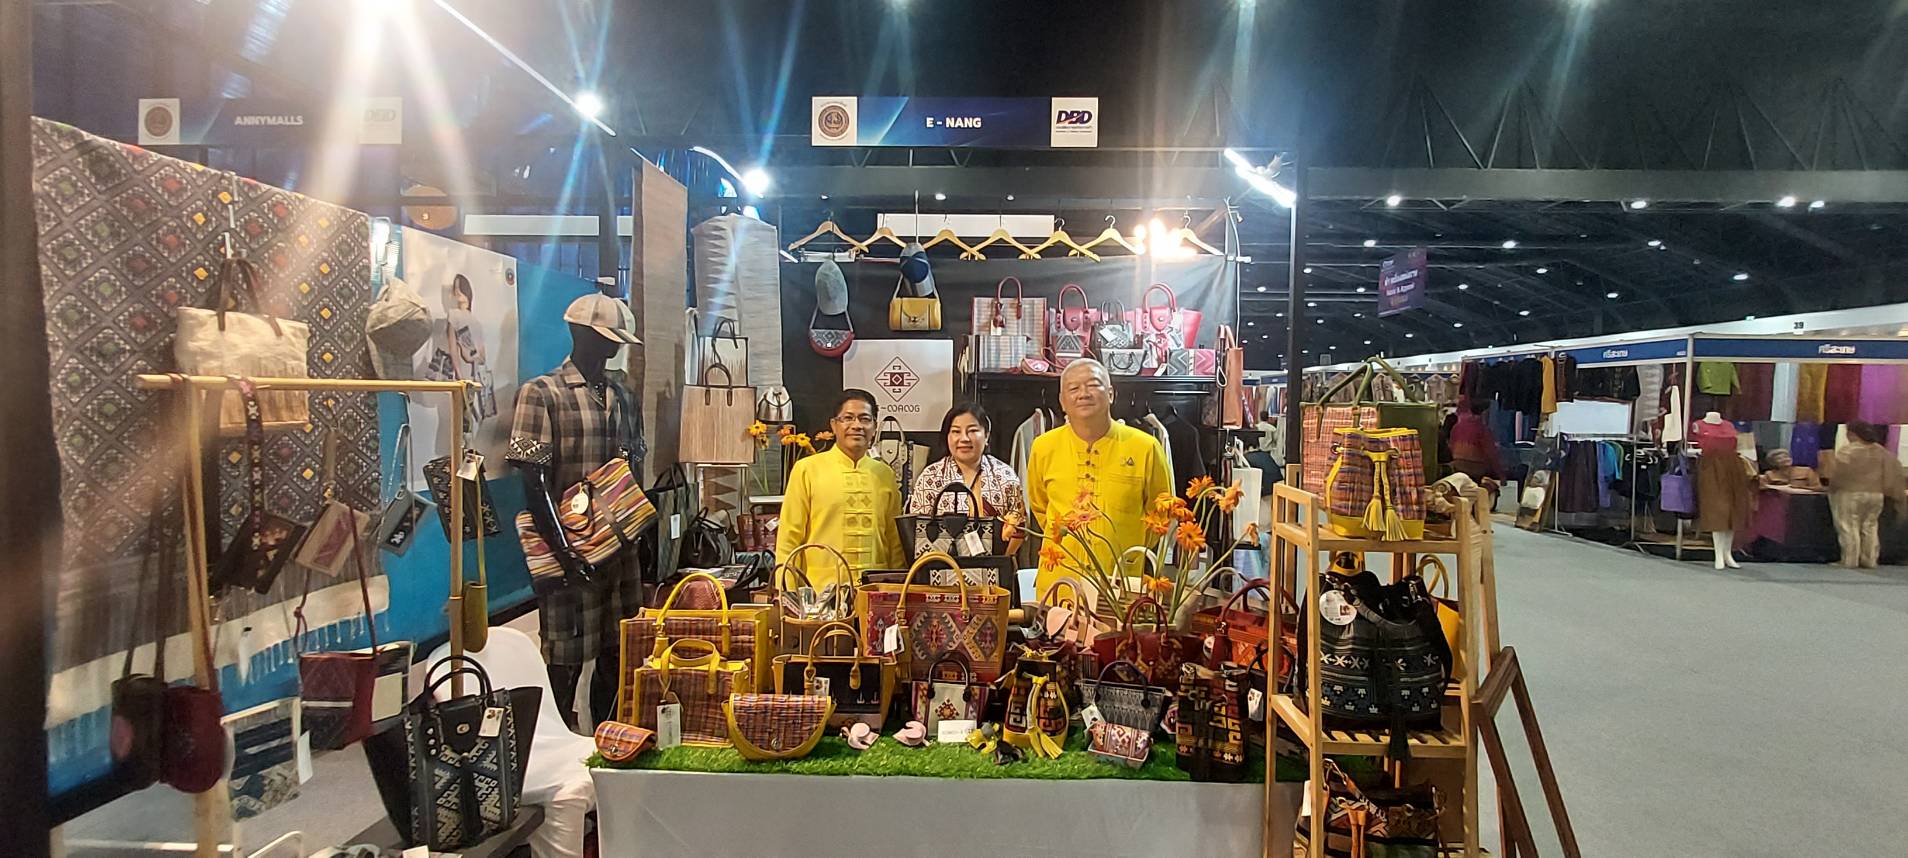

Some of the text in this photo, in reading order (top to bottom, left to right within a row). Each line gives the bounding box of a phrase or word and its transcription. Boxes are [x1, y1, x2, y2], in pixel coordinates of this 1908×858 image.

[234, 115, 304, 126] ANNYMALLS
[926, 117, 934, 128] E
[946, 117, 982, 128] NANG
[1056, 110, 1093, 125] DBD
[1793, 321, 1804, 330] 39
